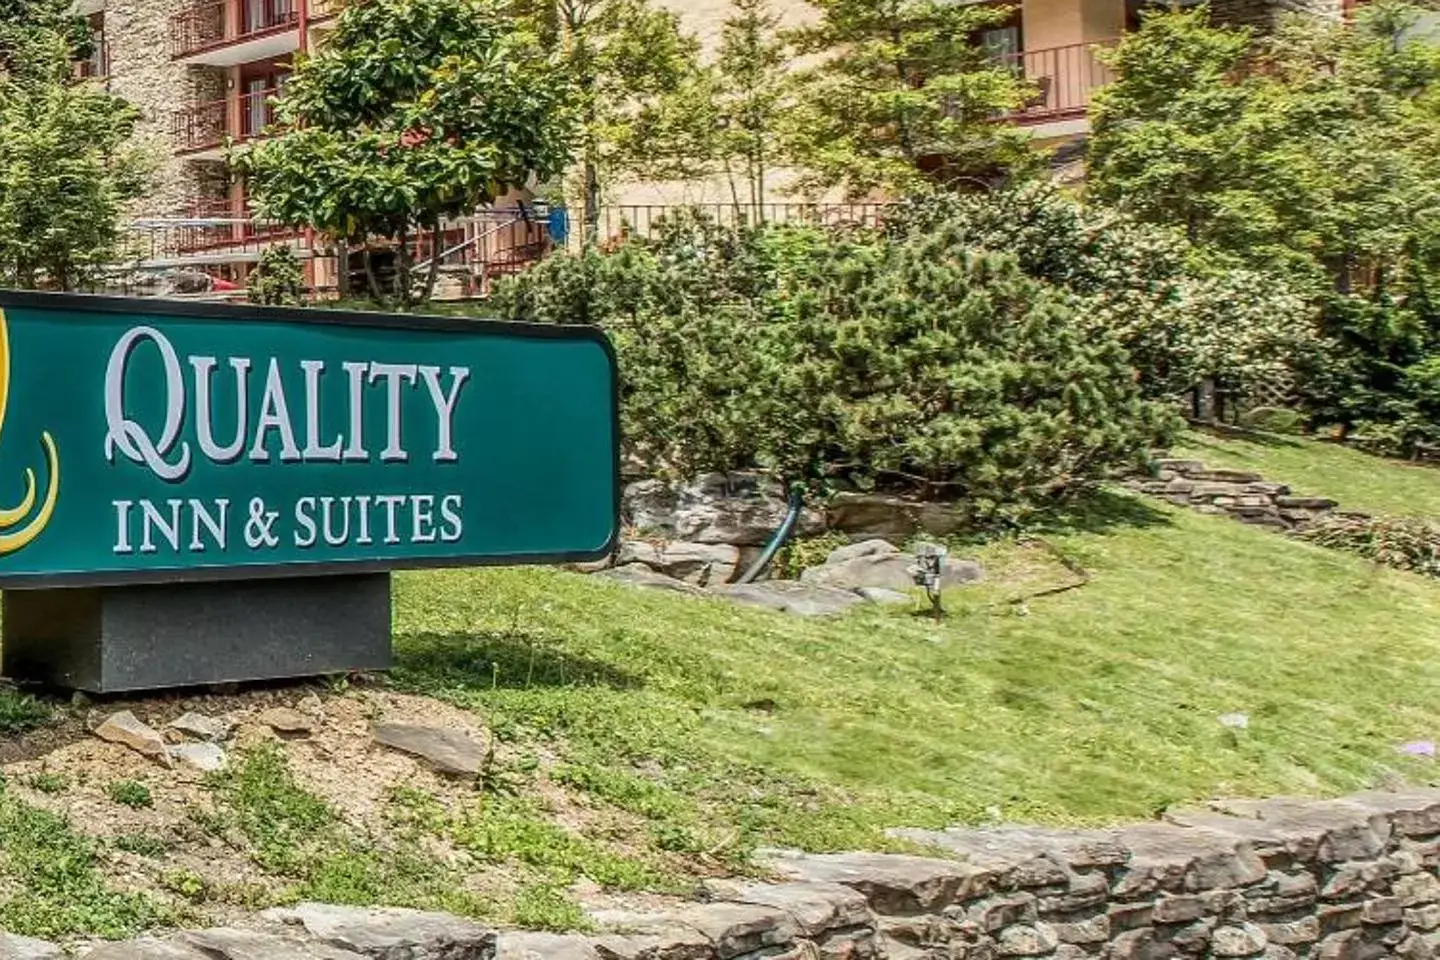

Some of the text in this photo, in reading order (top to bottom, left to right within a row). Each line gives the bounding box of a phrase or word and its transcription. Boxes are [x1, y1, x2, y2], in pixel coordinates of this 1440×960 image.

[104, 326, 470, 479] QUALITY
[112, 495, 463, 552] INN & SUITES
